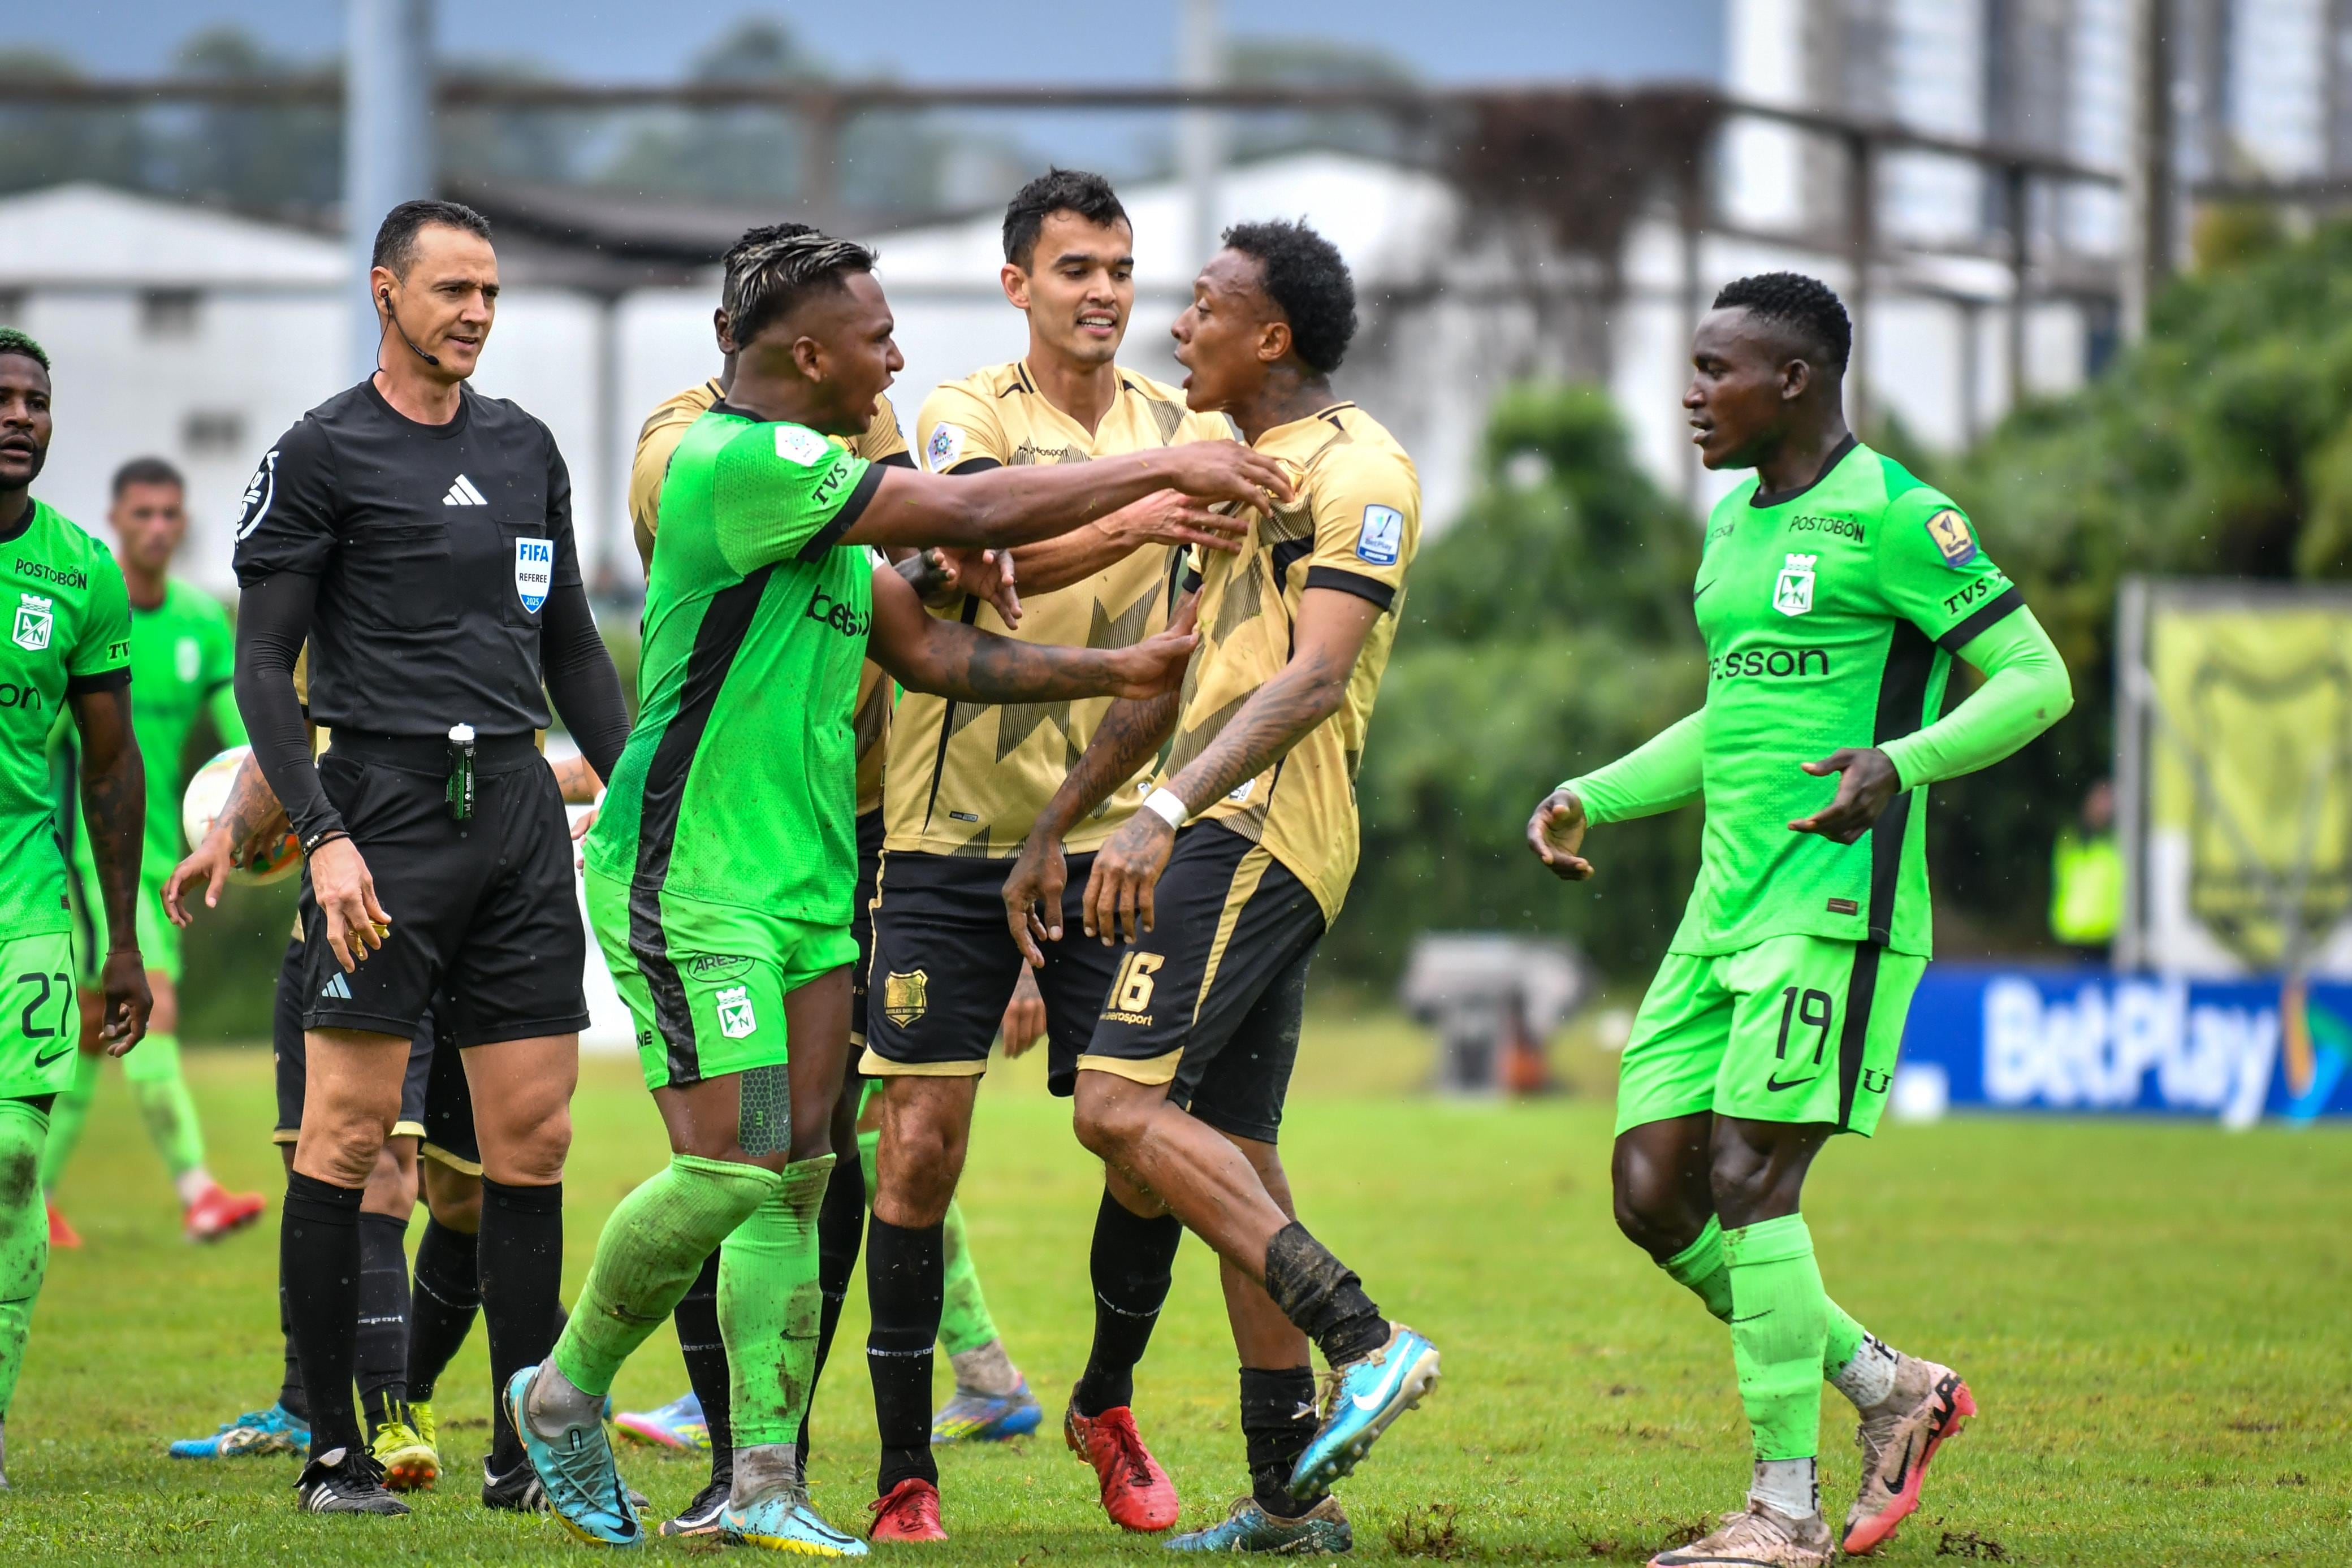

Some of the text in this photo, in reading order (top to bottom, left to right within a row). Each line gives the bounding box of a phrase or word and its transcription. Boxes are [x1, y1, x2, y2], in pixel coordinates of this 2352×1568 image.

[811, 462, 848, 505] TVS
[520, 544, 549, 562] FIFA
[519, 573, 547, 583] REFEREE
[1943, 578, 1987, 615] TVS
[526, 597, 539, 606] 2025
[806, 584, 870, 637] bets
[1107, 951, 1165, 1013] 16
[17, 972, 73, 1039] 27
[1775, 986, 1832, 1065] 19
[1983, 972, 2282, 1132] BetPlay
[357, 1315, 404, 1325] sport
[871, 1344, 936, 1358] aerospor
